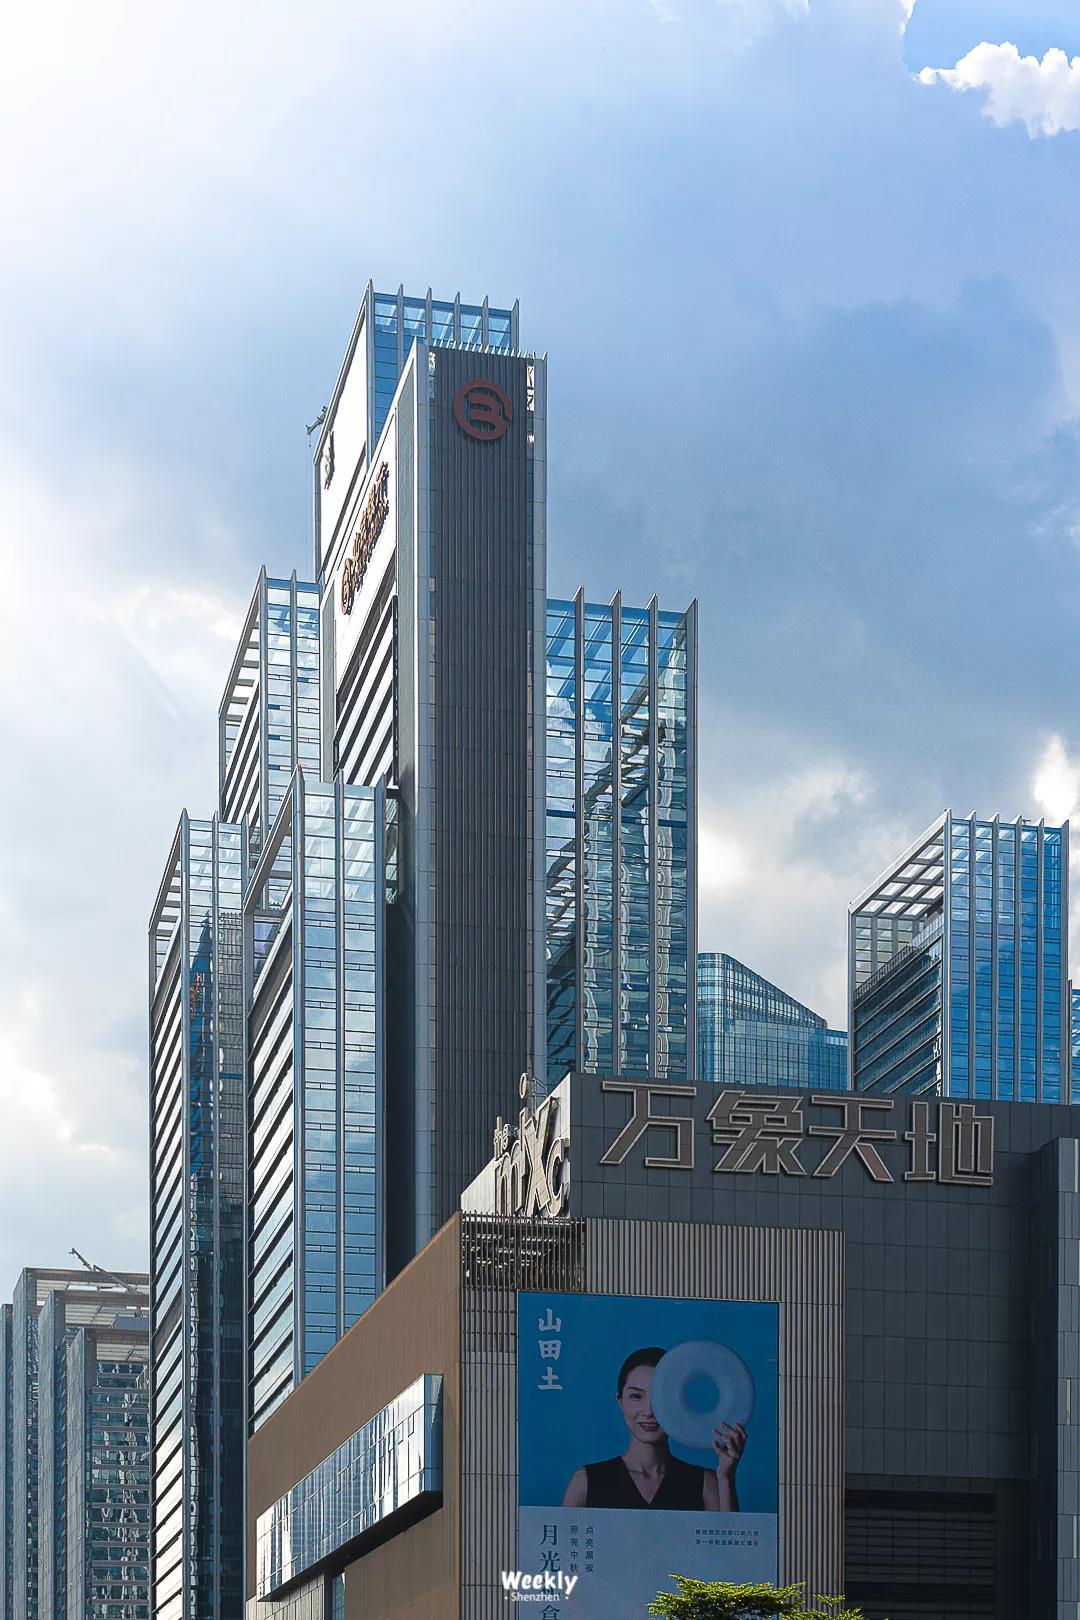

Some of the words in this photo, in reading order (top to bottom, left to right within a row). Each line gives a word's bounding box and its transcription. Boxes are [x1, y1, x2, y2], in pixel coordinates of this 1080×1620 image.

[599, 1080, 995, 1186] 万象天地
[538, 1308, 563, 1390] 山田土
[570, 1524, 579, 1574] 照亮中秋
[585, 1525, 594, 1574] 点亮黑夜
